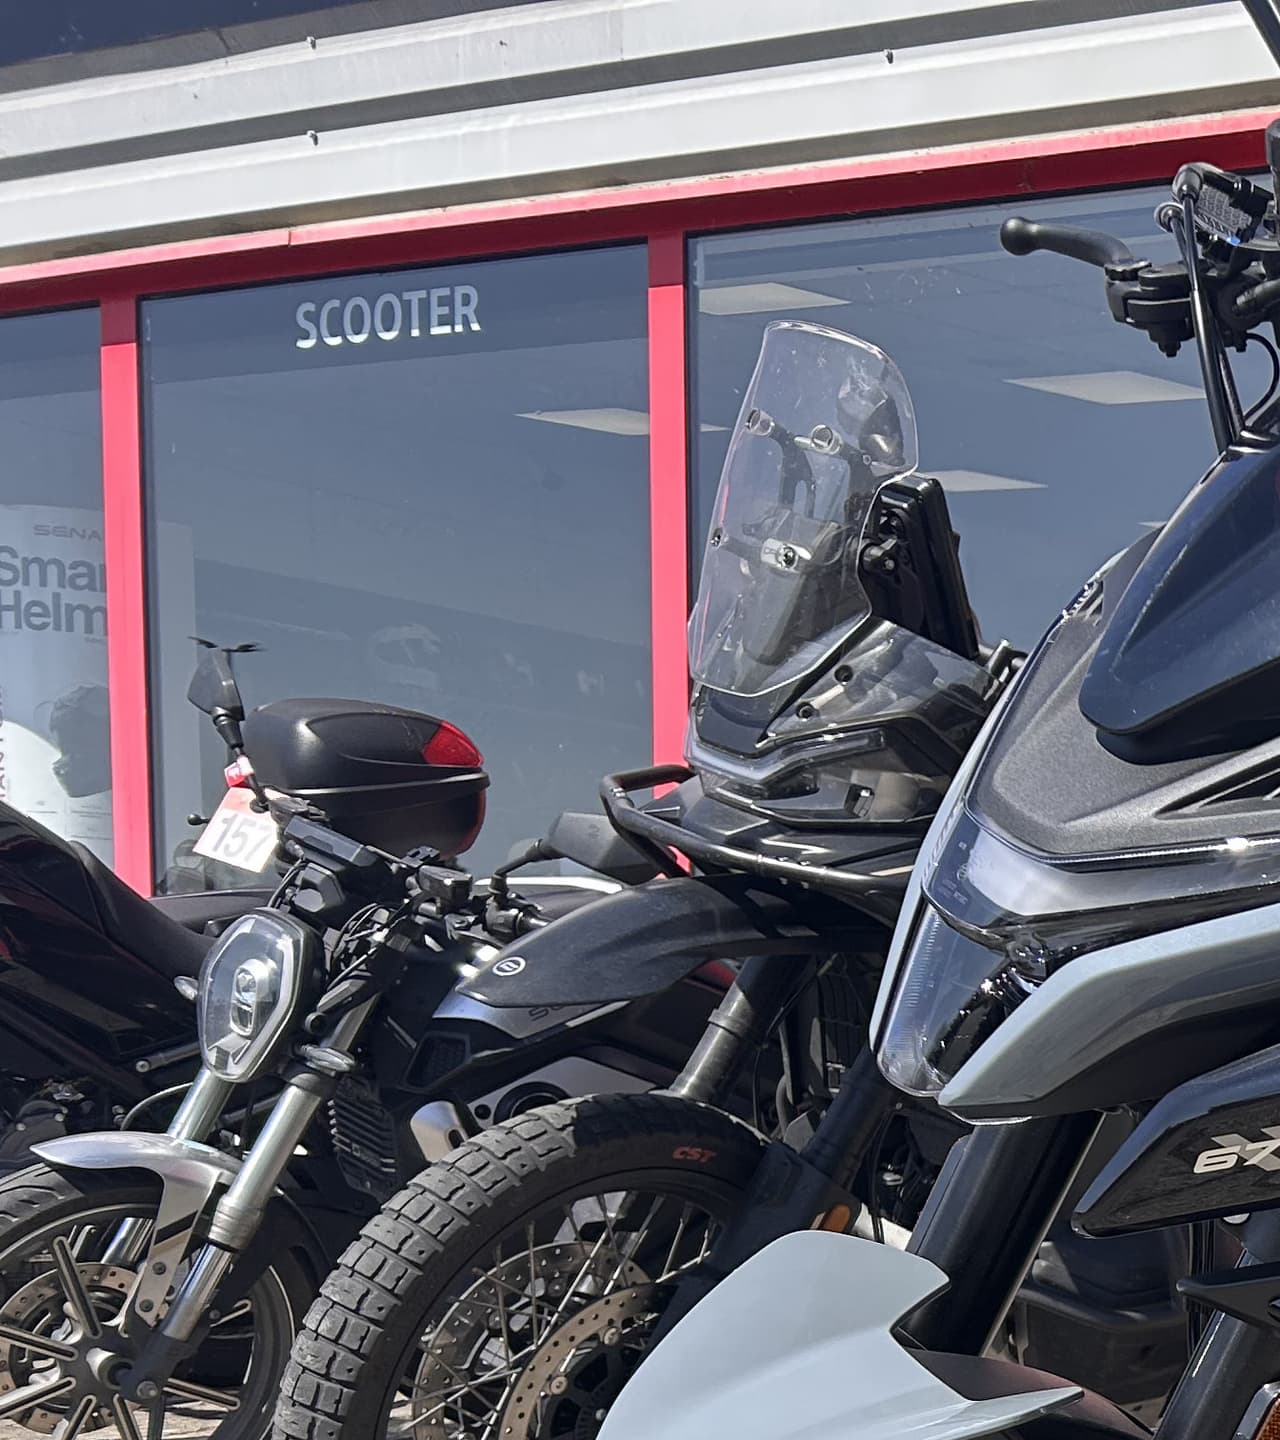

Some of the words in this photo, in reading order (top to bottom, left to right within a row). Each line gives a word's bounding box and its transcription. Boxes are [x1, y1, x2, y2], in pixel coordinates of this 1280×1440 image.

[296, 288, 481, 349] SCOOTER
[33, 524, 102, 542] SENA
[671, 1146, 717, 1162] CST
